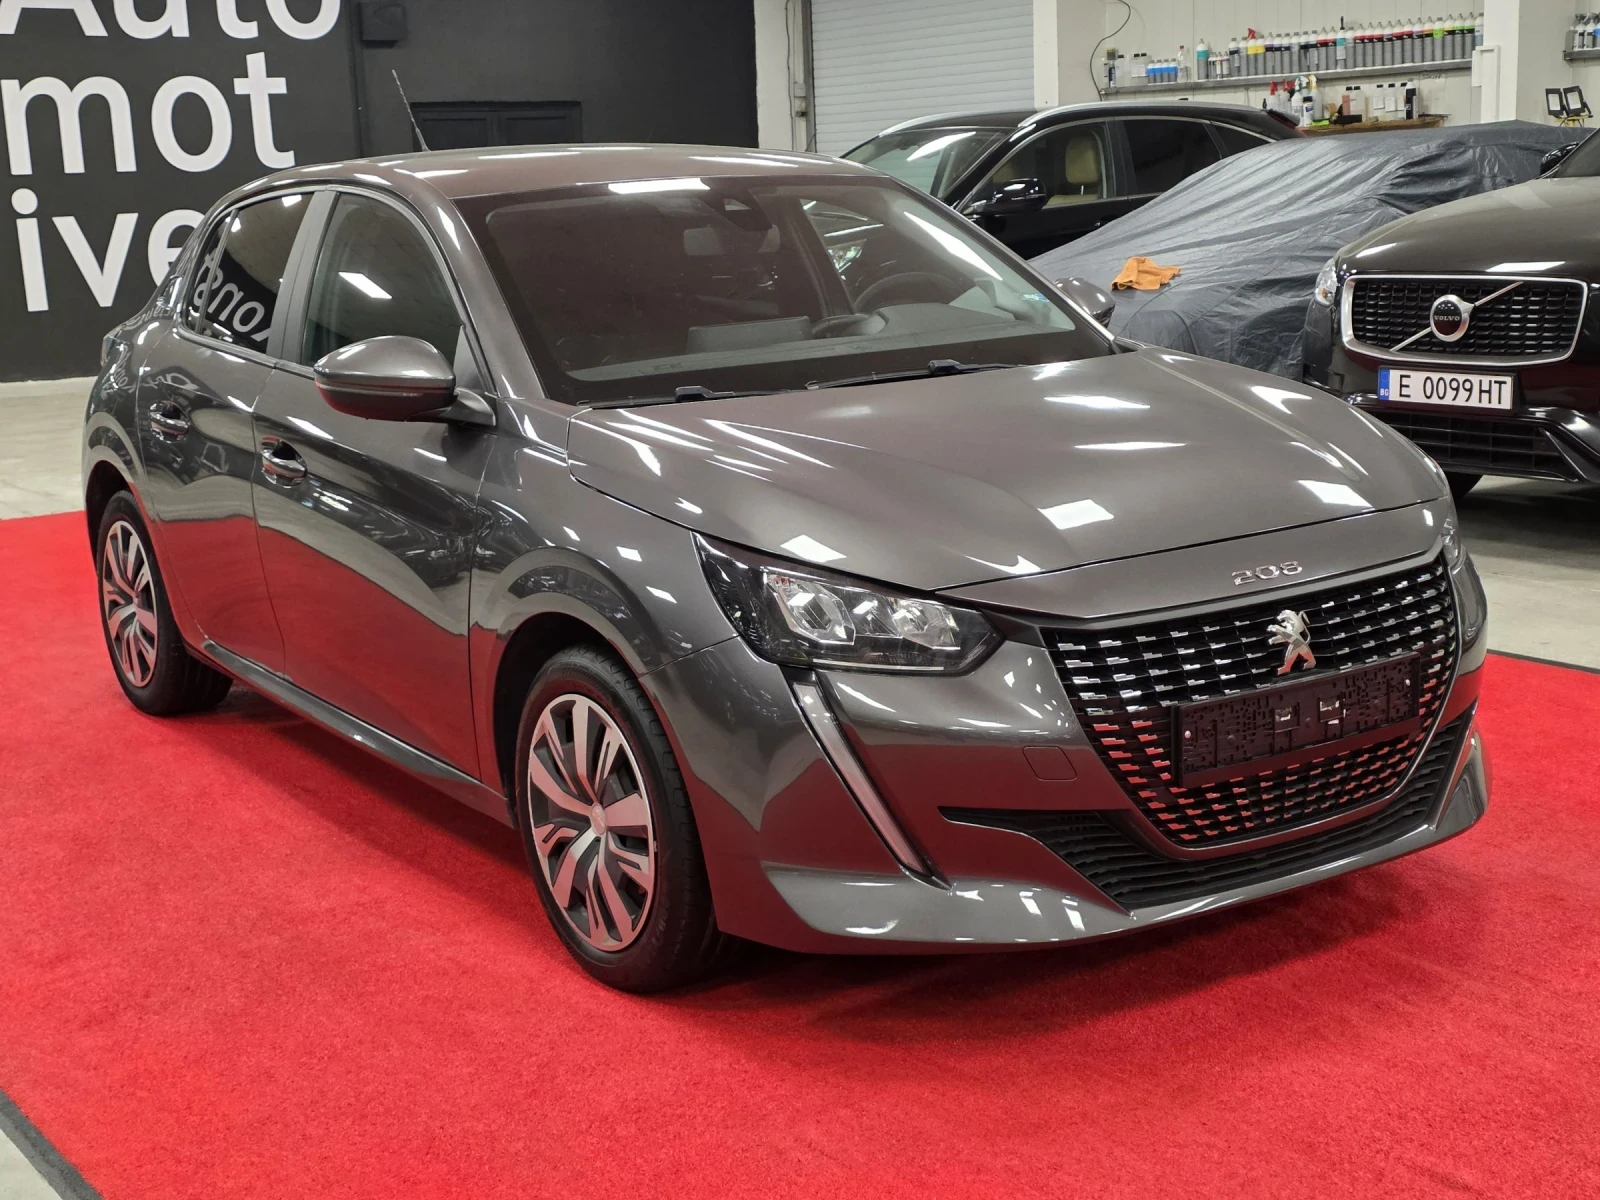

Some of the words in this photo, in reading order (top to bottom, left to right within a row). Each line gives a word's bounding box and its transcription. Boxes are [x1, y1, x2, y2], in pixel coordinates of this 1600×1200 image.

[0, 52, 295, 175] mot
[1380, 388, 1389, 396] BG
[1399, 374, 1411, 398] E
[1423, 376, 1474, 402] 0099
[1478, 379, 1507, 405] HT
[1231, 561, 1303, 586] 208
